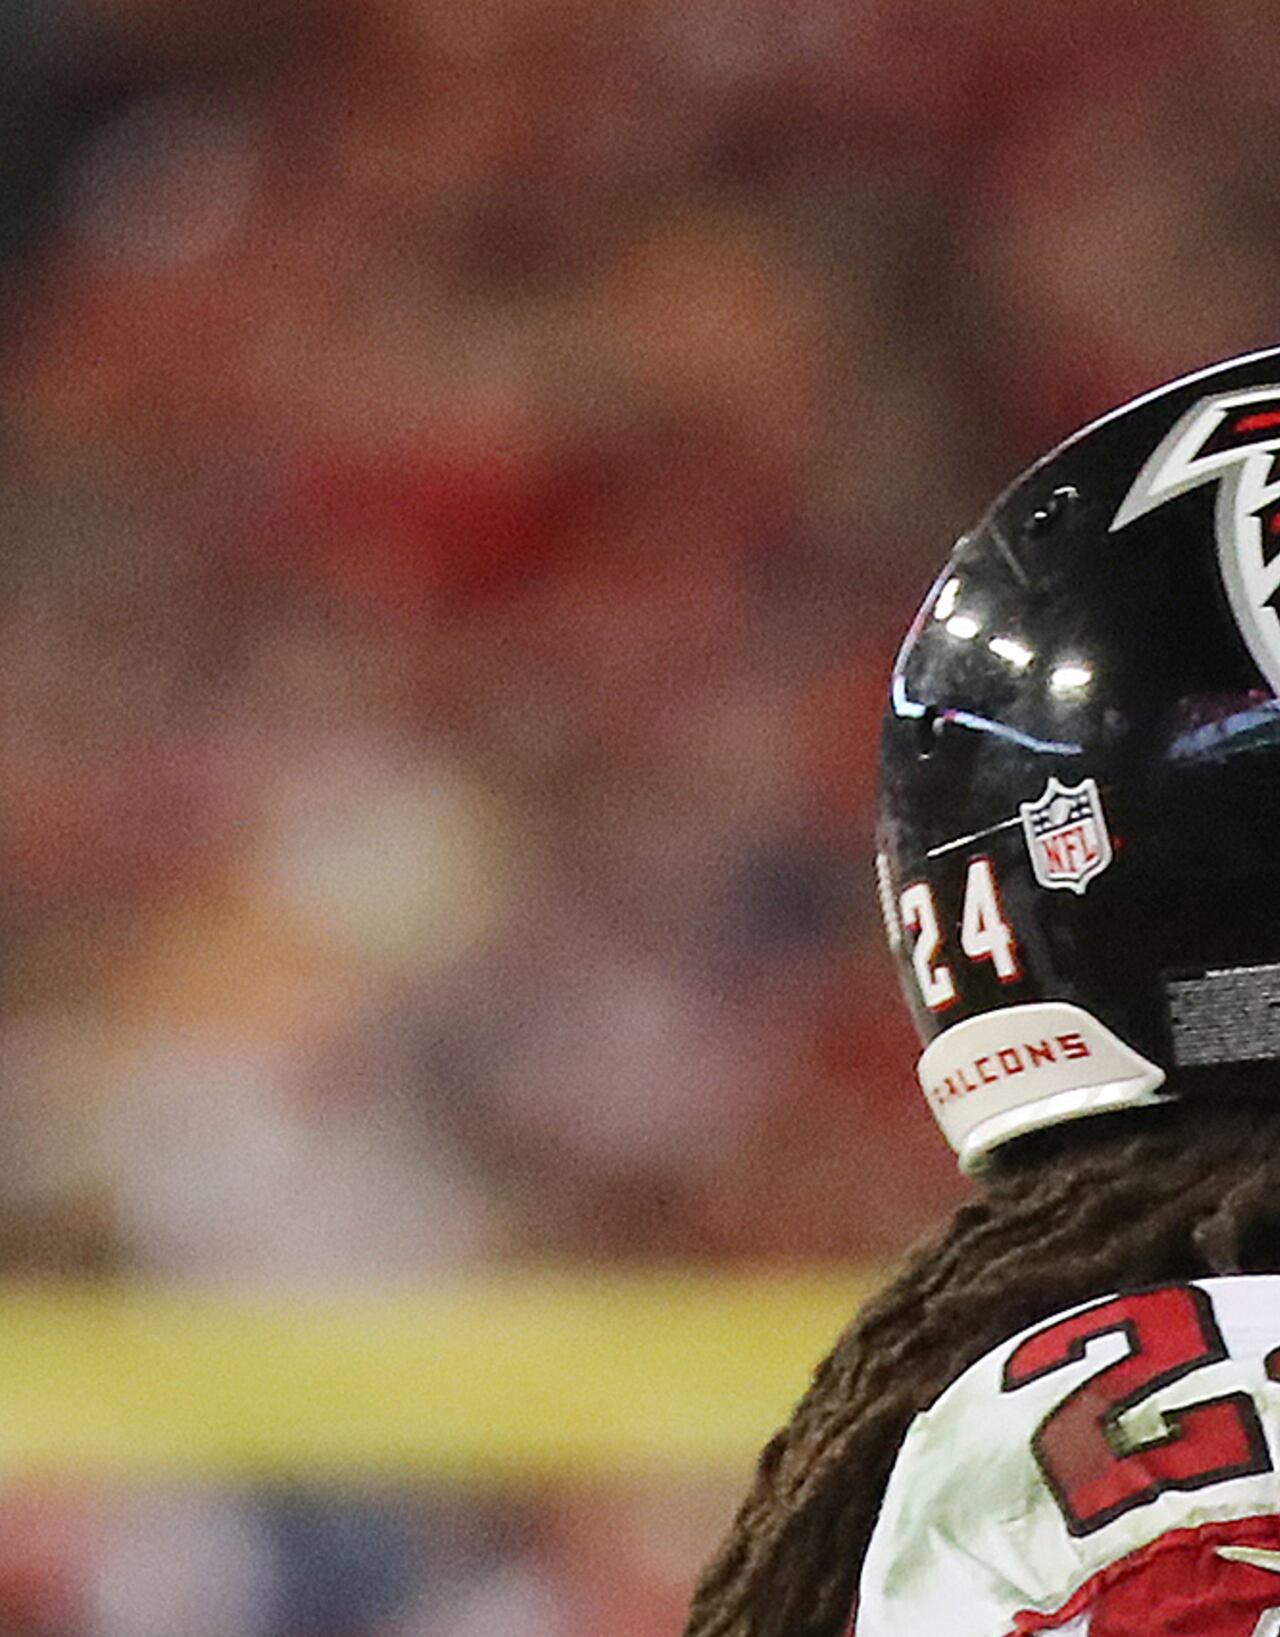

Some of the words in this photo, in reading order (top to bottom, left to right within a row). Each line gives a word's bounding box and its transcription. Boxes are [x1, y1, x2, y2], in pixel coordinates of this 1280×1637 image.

[1041, 826, 1101, 874] NFL
[900, 855, 1022, 1011] 24
[932, 1032, 1091, 1105] ALCONS
